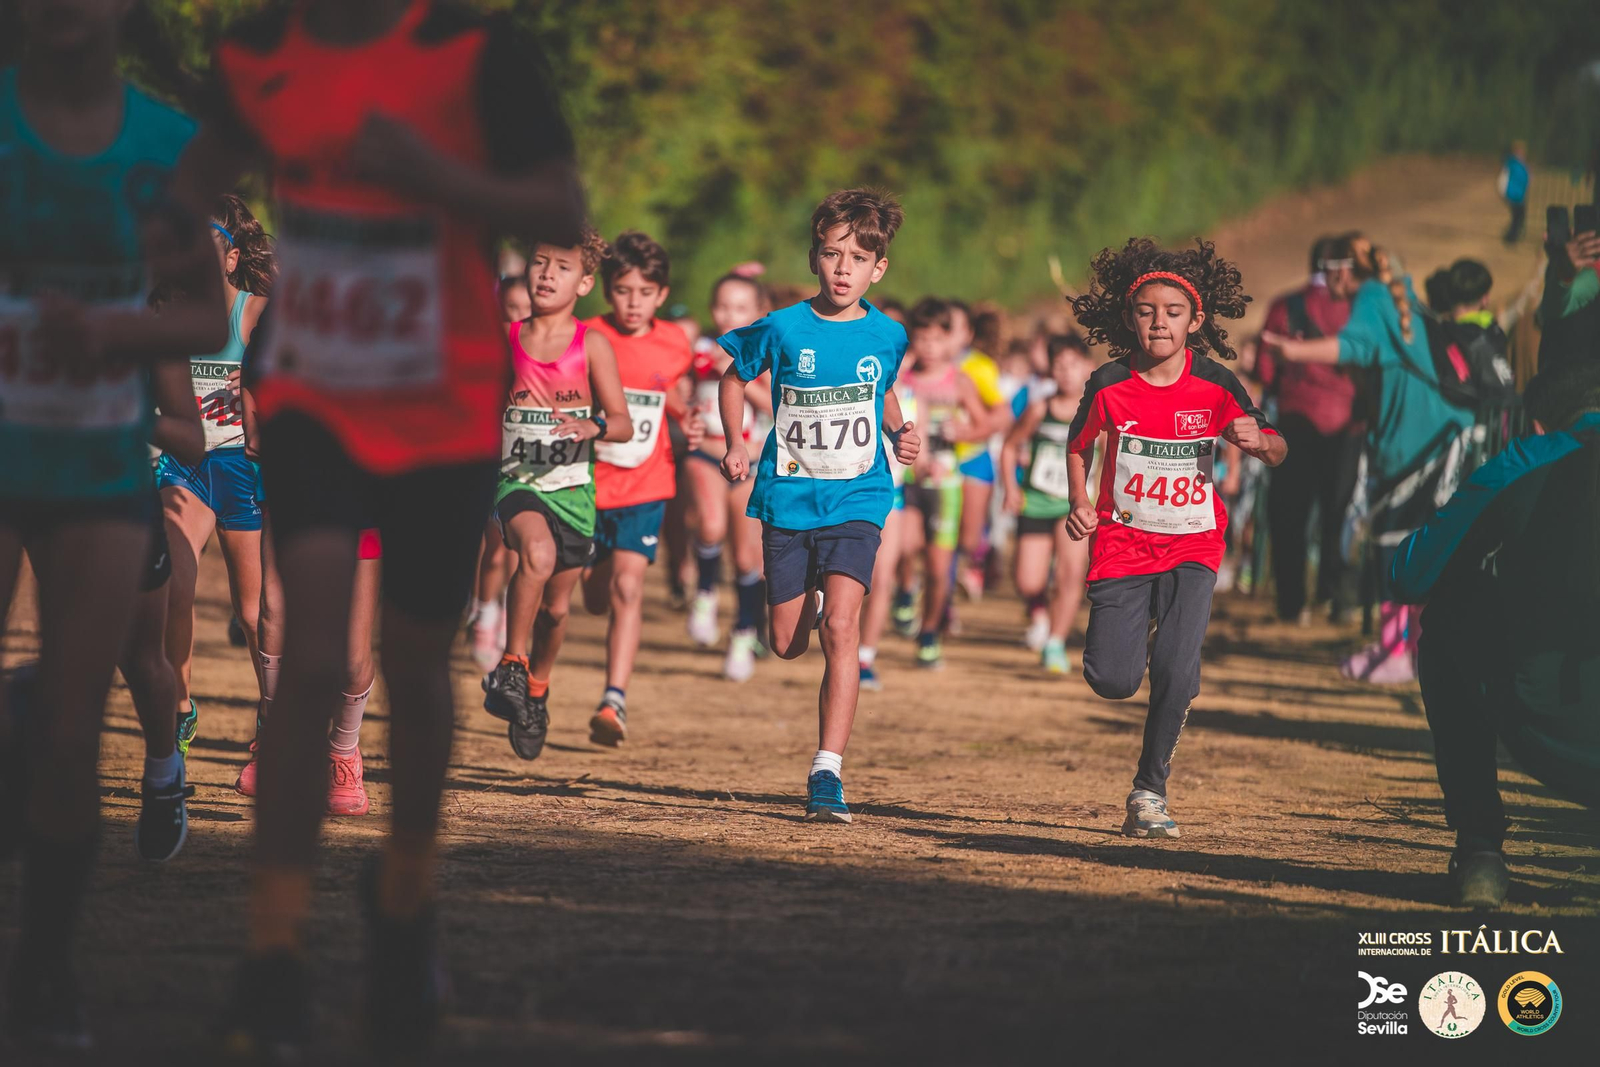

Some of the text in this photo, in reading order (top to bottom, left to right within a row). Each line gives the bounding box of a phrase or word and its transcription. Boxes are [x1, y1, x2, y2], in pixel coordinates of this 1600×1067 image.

[191, 363, 229, 377] TÁLICA
[803, 390, 850, 404] ITÁLICA
[785, 416, 871, 450] 4170
[511, 436, 585, 466] 4187
[1149, 443, 1195, 456] ITÁLICA
[1123, 473, 1207, 507] 4488
